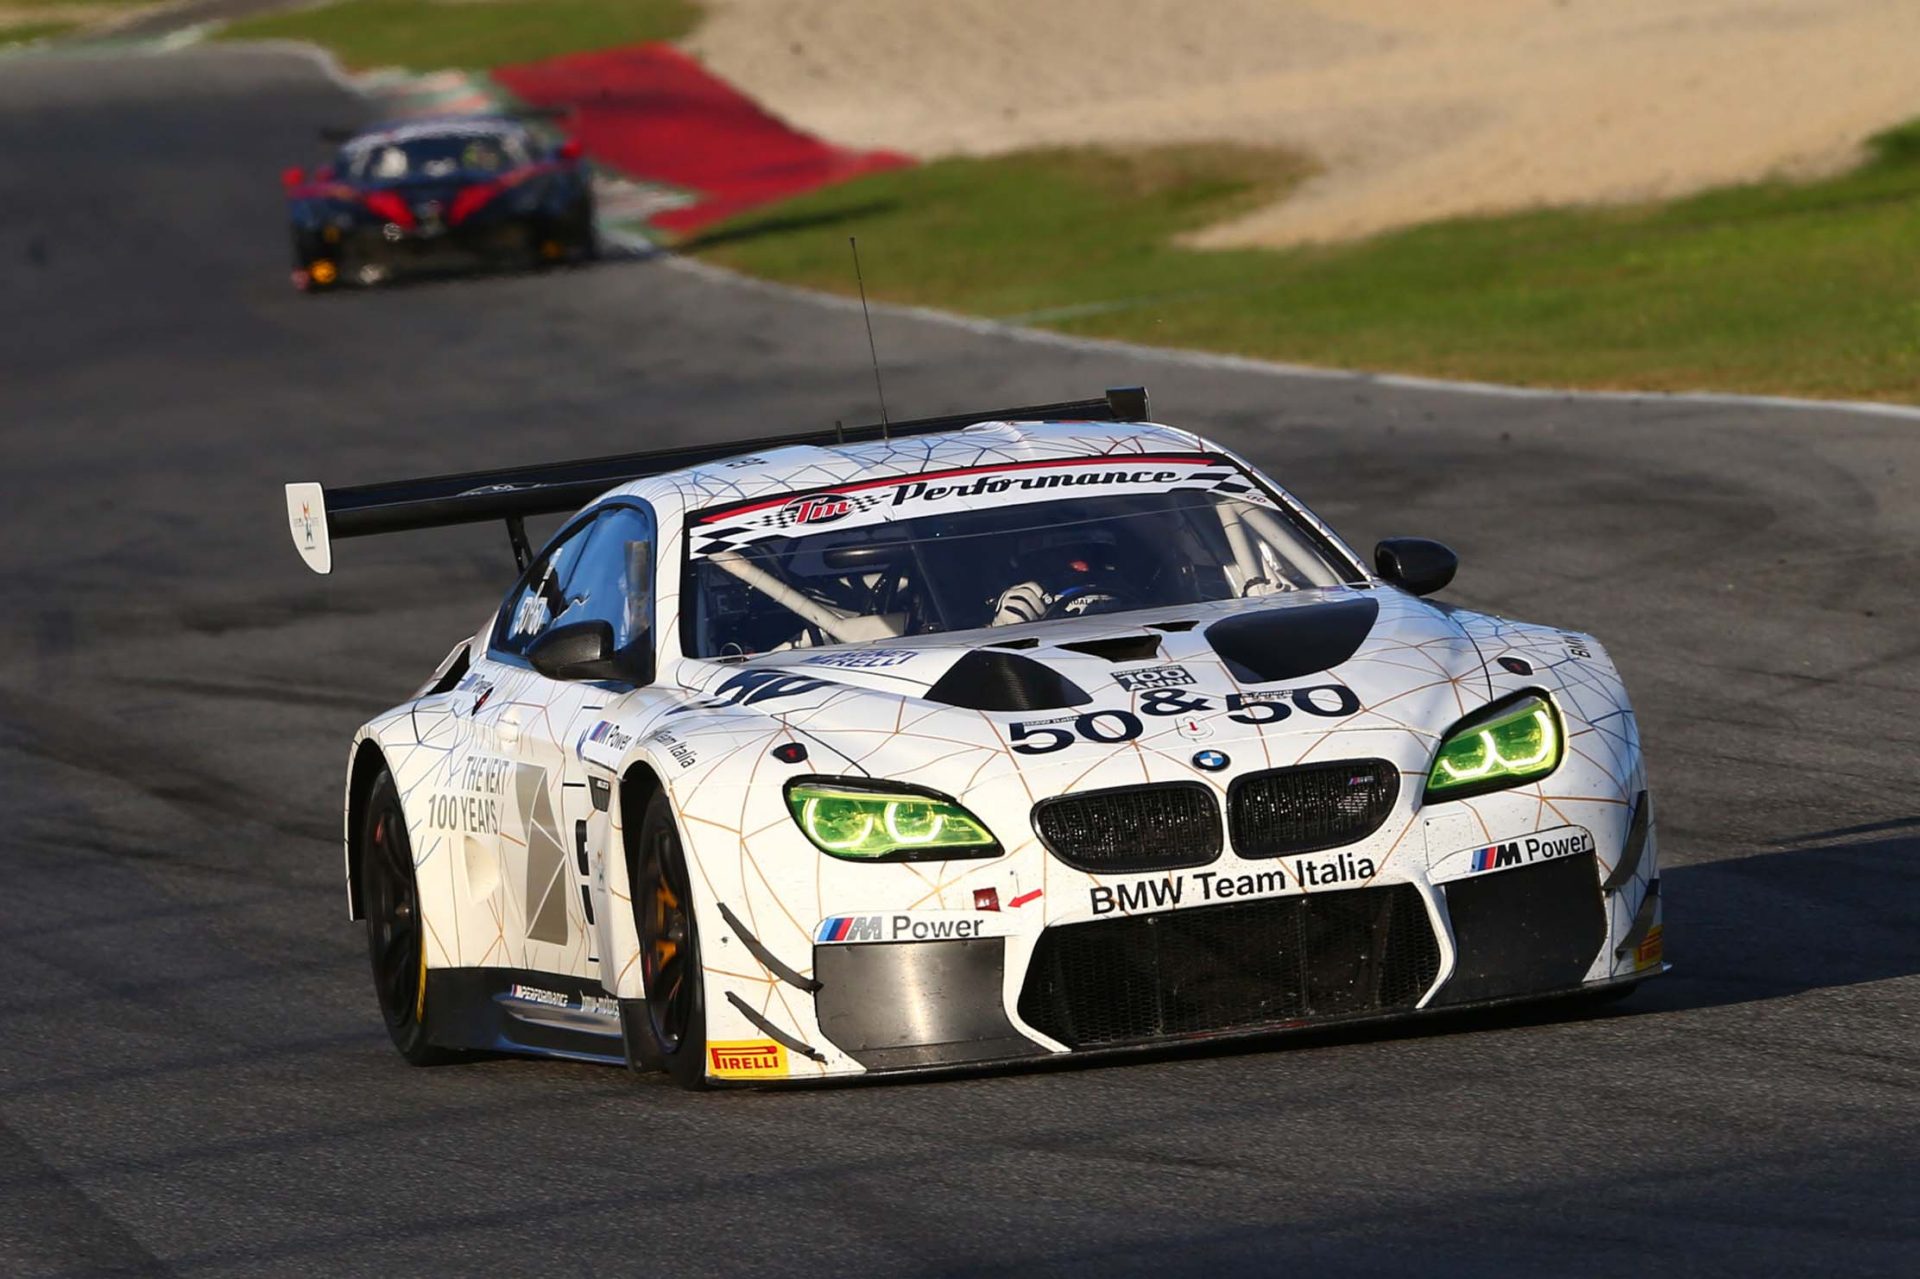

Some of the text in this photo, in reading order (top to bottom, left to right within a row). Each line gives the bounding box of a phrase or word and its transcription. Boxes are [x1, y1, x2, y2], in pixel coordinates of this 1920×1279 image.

[889, 471, 1183, 506] Performance
[1118, 668, 1186, 684] 100
[1129, 676, 1194, 691] ANNI
[1009, 684, 1361, 755] 50 & 50
[666, 741, 698, 769] Italia
[461, 755, 510, 796] THE NEXT
[428, 793, 498, 835] 100 YEARS
[1525, 833, 1589, 862] Power
[1089, 852, 1376, 915] BMW Team Italia
[892, 915, 984, 940] Power
[710, 1045, 779, 1070] PIRELLI
